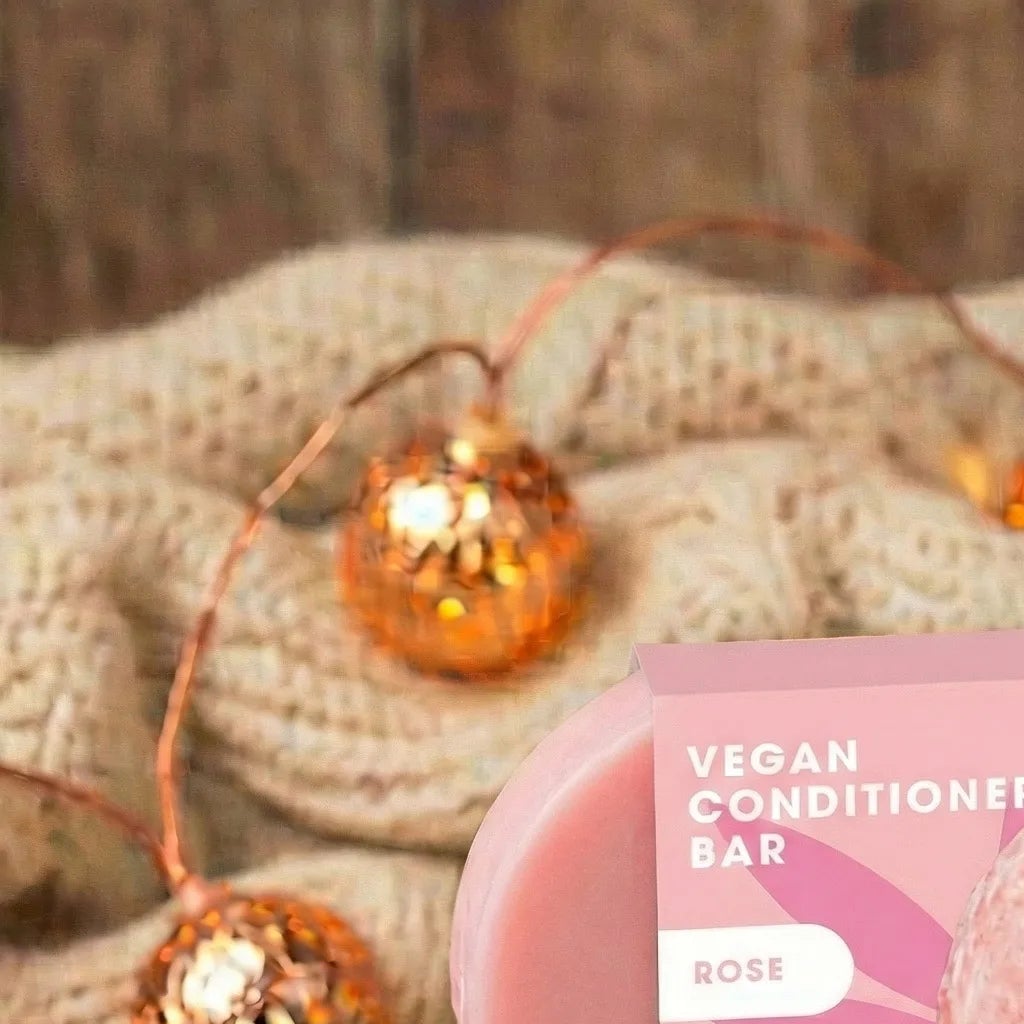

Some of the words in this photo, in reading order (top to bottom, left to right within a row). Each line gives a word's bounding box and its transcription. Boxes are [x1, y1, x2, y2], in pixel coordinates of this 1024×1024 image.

[686, 739, 858, 778] VEGAN
[690, 833, 786, 869] BAR
[694, 957, 784, 985] ROSE
